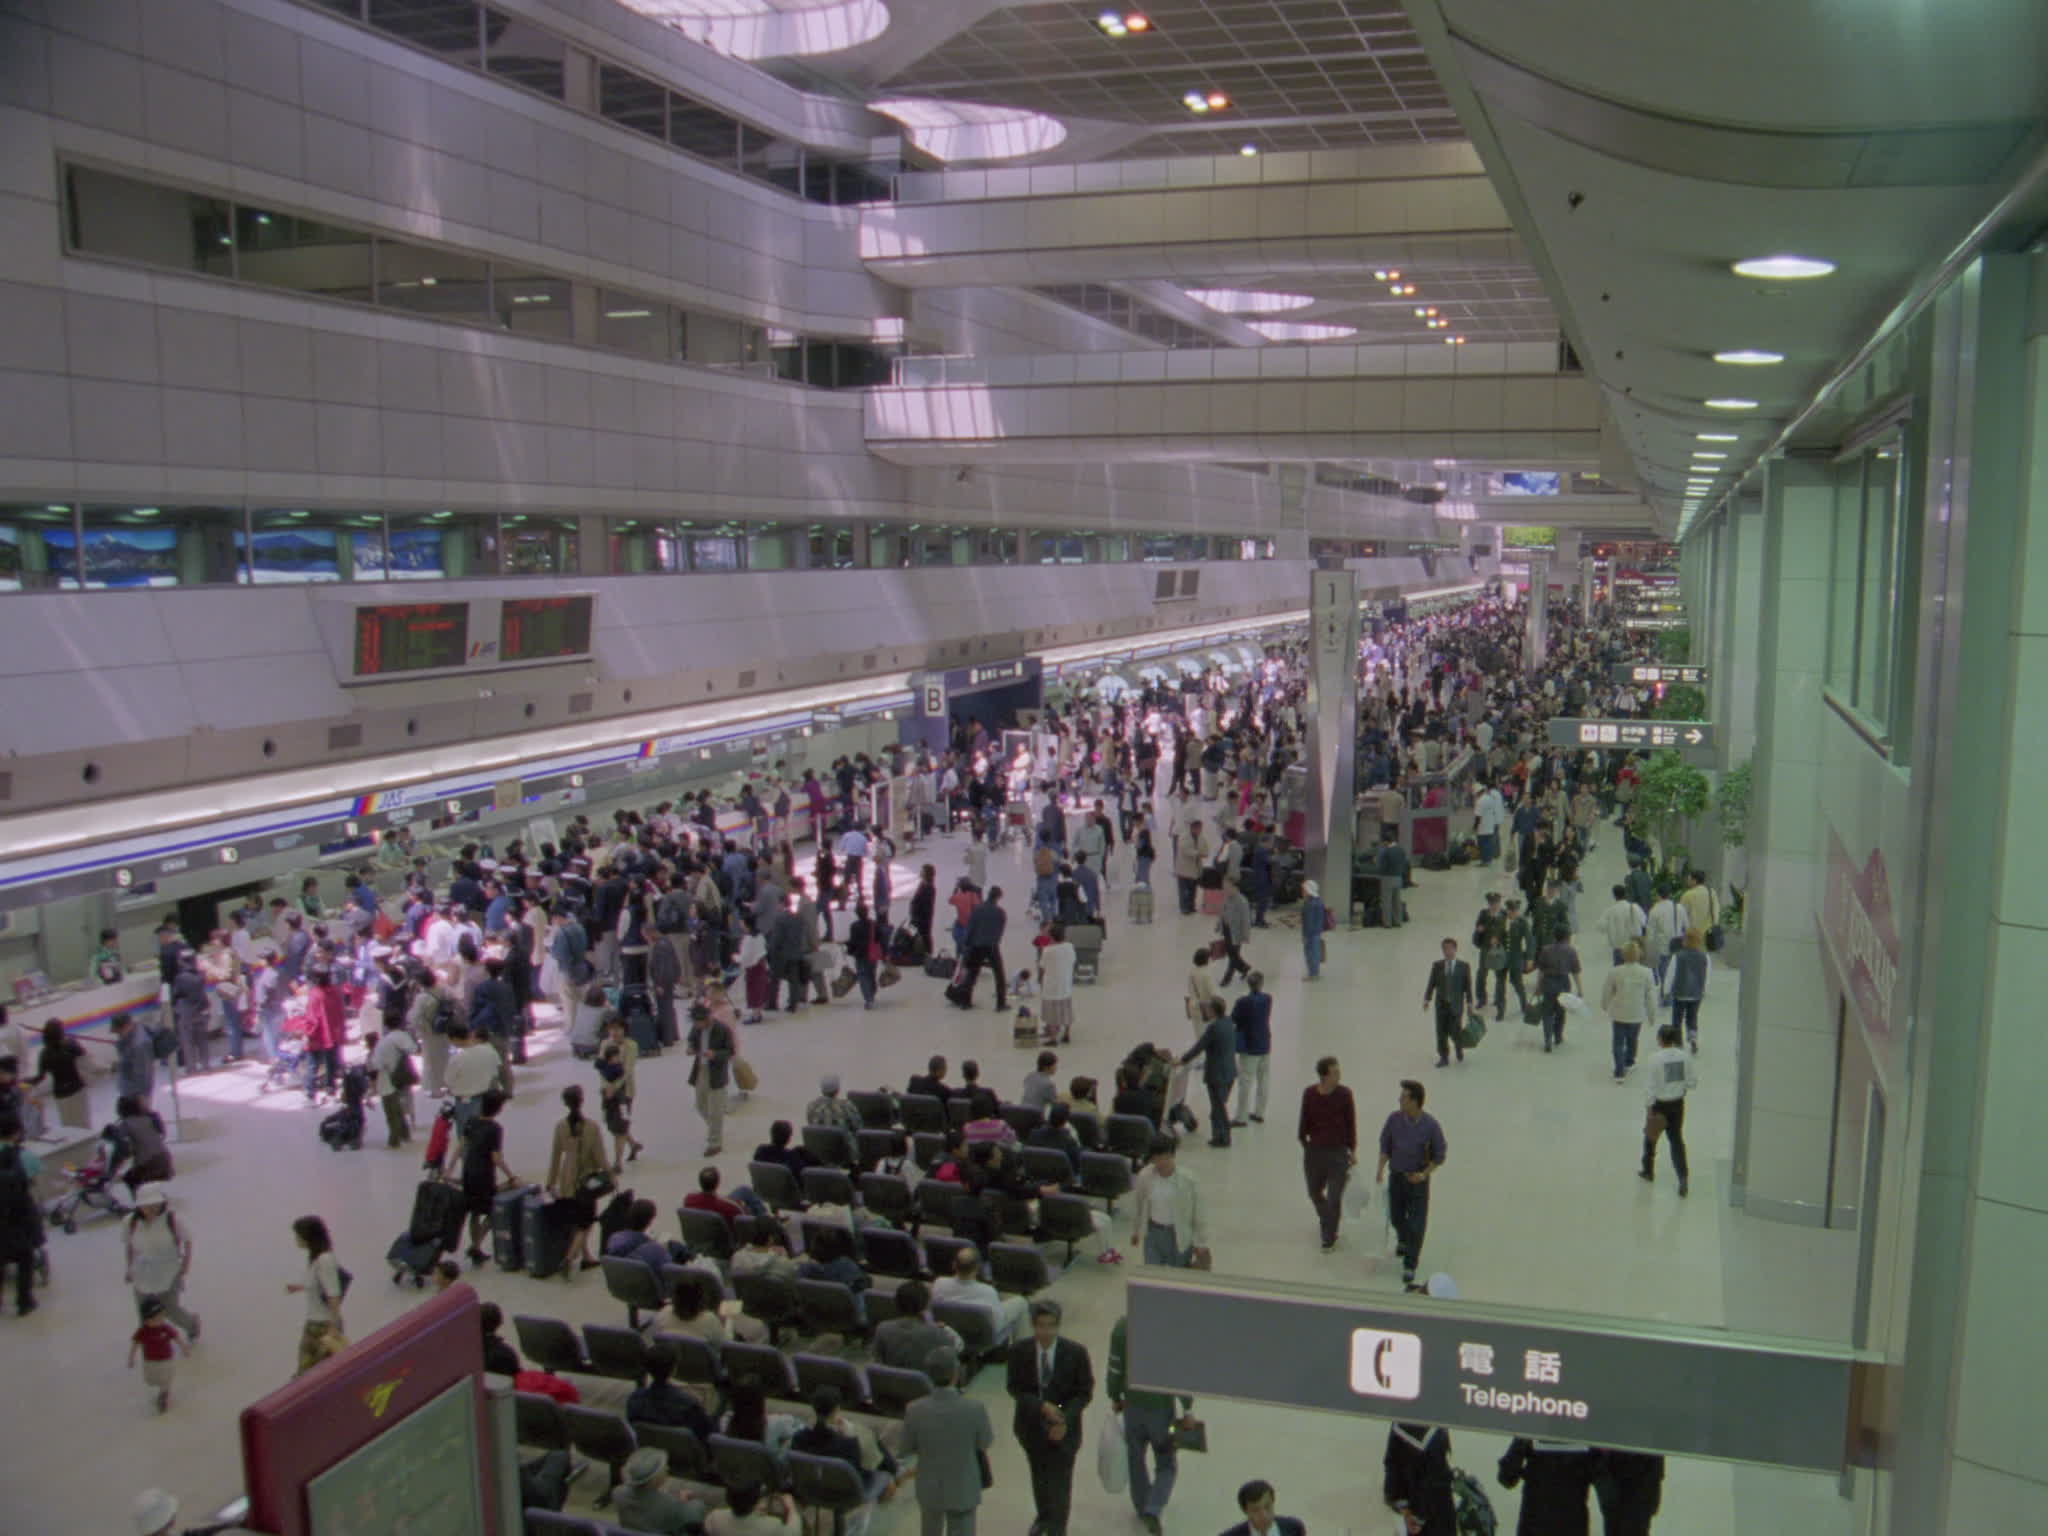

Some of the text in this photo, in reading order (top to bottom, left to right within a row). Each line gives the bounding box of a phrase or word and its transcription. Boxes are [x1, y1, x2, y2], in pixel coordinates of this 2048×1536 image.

[928, 688, 941, 712] B
[1459, 1342, 1562, 1384] 電話
[1460, 1383, 1589, 1419] Telephone
